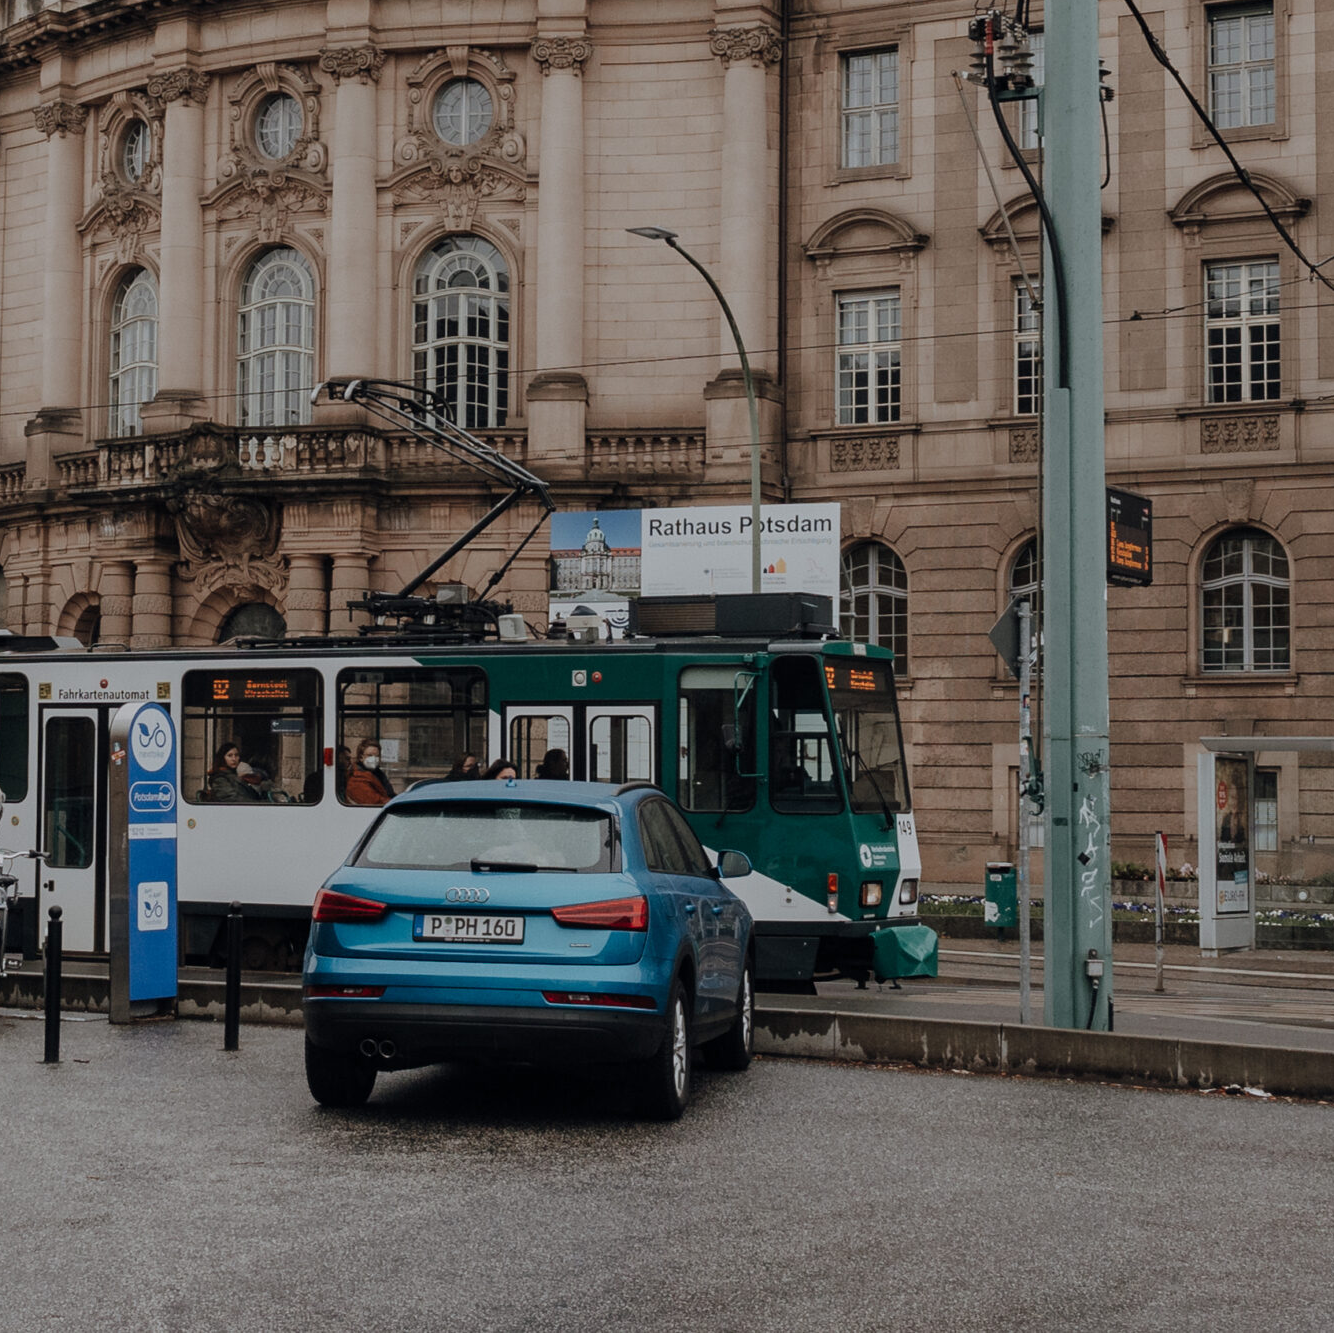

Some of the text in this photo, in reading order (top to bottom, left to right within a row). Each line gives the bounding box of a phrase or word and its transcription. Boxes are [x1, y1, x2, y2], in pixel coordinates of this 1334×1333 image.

[649, 518, 732, 536] Rathaus
[58, 688, 150, 700] Fahrkartenautomat
[133, 792, 171, 802] PotsdamRad
[898, 820, 912, 836] 149
[431, 917, 516, 937] P PH 160
